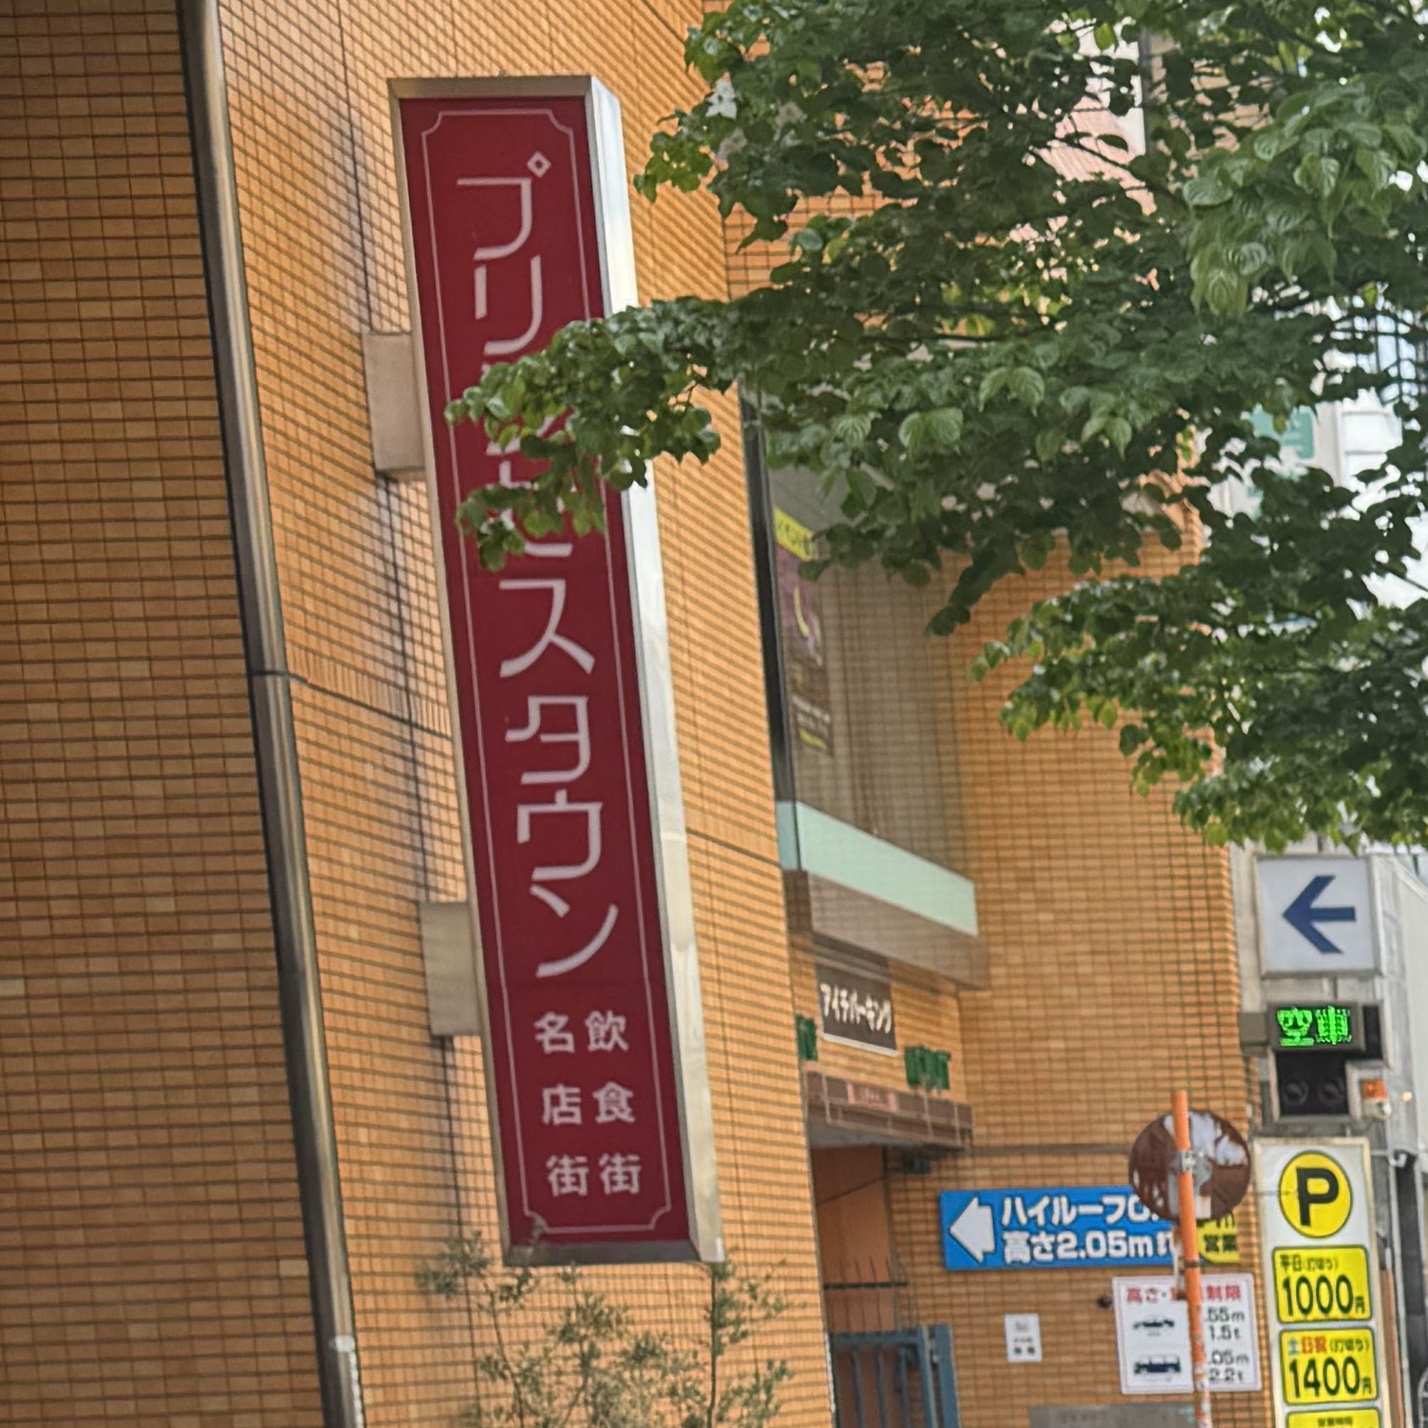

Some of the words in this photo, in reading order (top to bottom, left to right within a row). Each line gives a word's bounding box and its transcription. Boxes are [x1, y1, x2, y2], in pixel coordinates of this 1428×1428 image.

[457, 153, 617, 978] プリスタウン
[1276, 1006, 1352, 1047] 空車
[533, 1012, 588, 1197] 名店街
[584, 1010, 642, 1195] 飲食街
[1296, 1167, 1340, 1227] P
[1203, 1306, 1246, 1323] .55m
[1282, 1274, 1366, 1317] 1000円
[1206, 1349, 1250, 1366] .05m
[1289, 1356, 1373, 1399] 1400円
